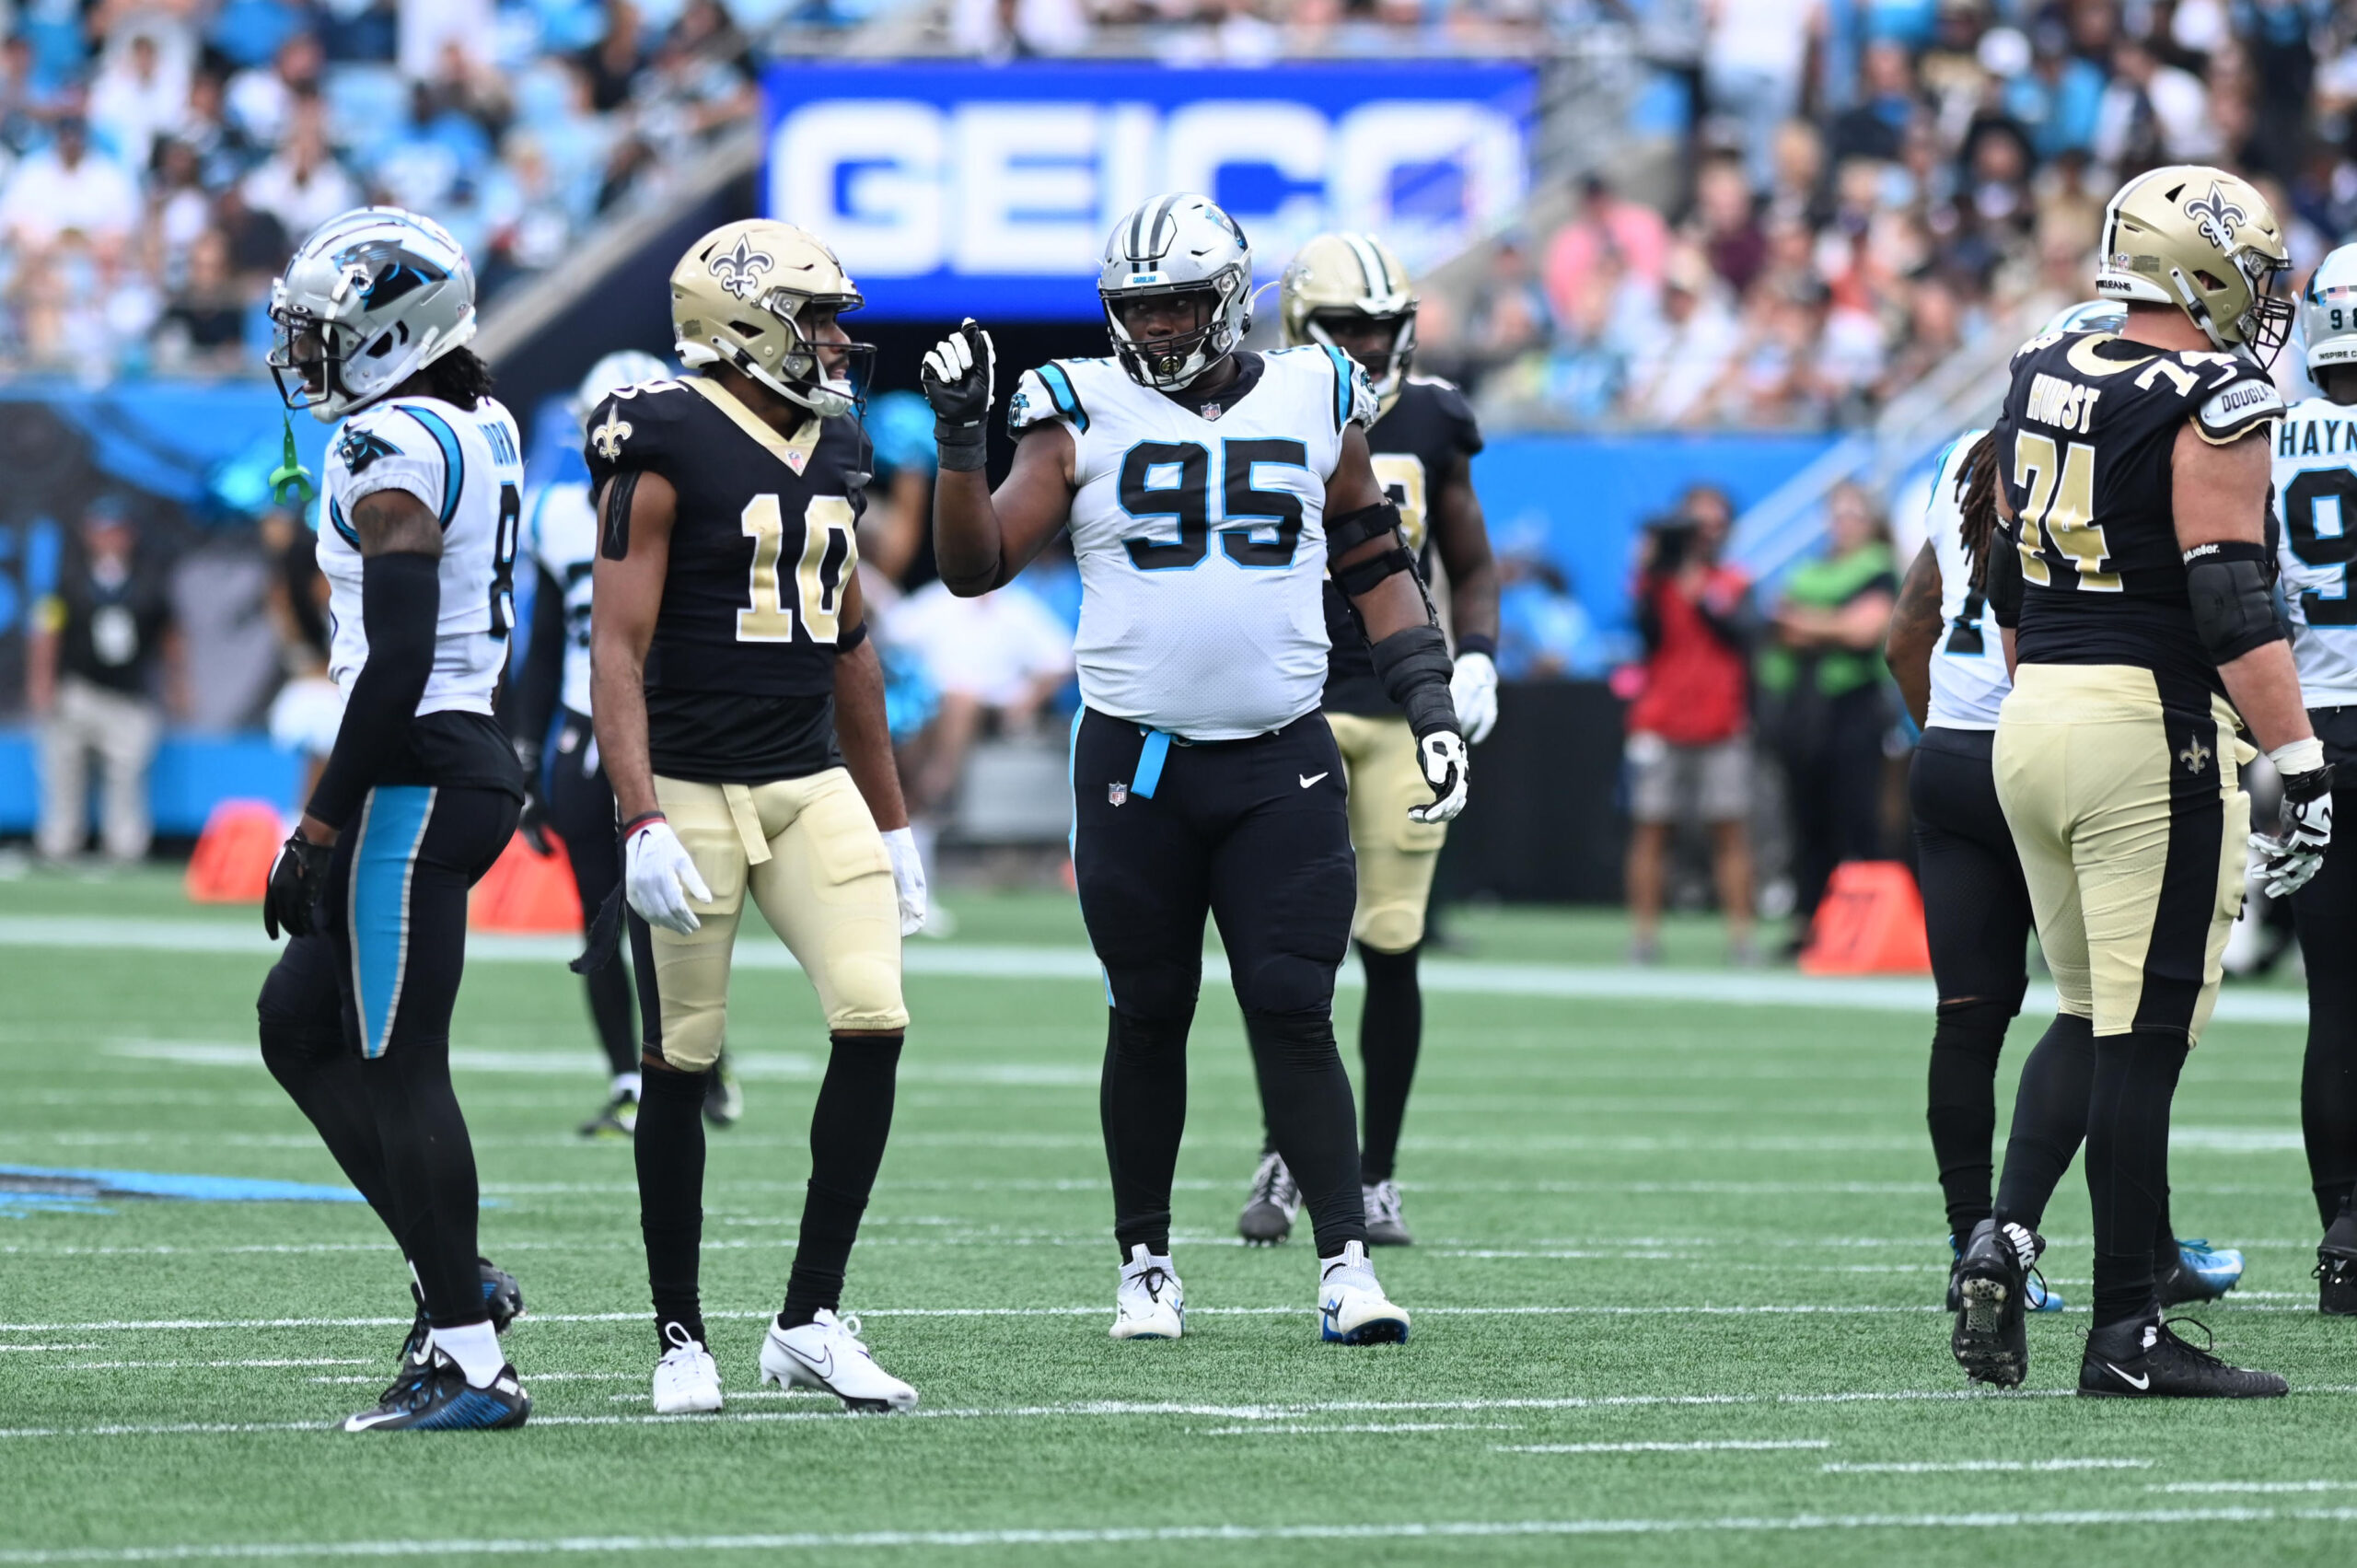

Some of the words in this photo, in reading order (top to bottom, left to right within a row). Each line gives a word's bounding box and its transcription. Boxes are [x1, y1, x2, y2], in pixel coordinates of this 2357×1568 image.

[768, 100, 1524, 276] GEICO
[2026, 372, 2101, 435] HURST
[2318, 351, 2348, 360] INSPIRE
[489, 480, 521, 644] 8
[736, 494, 858, 644] 10
[1117, 436, 1309, 571] 95
[2014, 429, 2123, 592] 74
